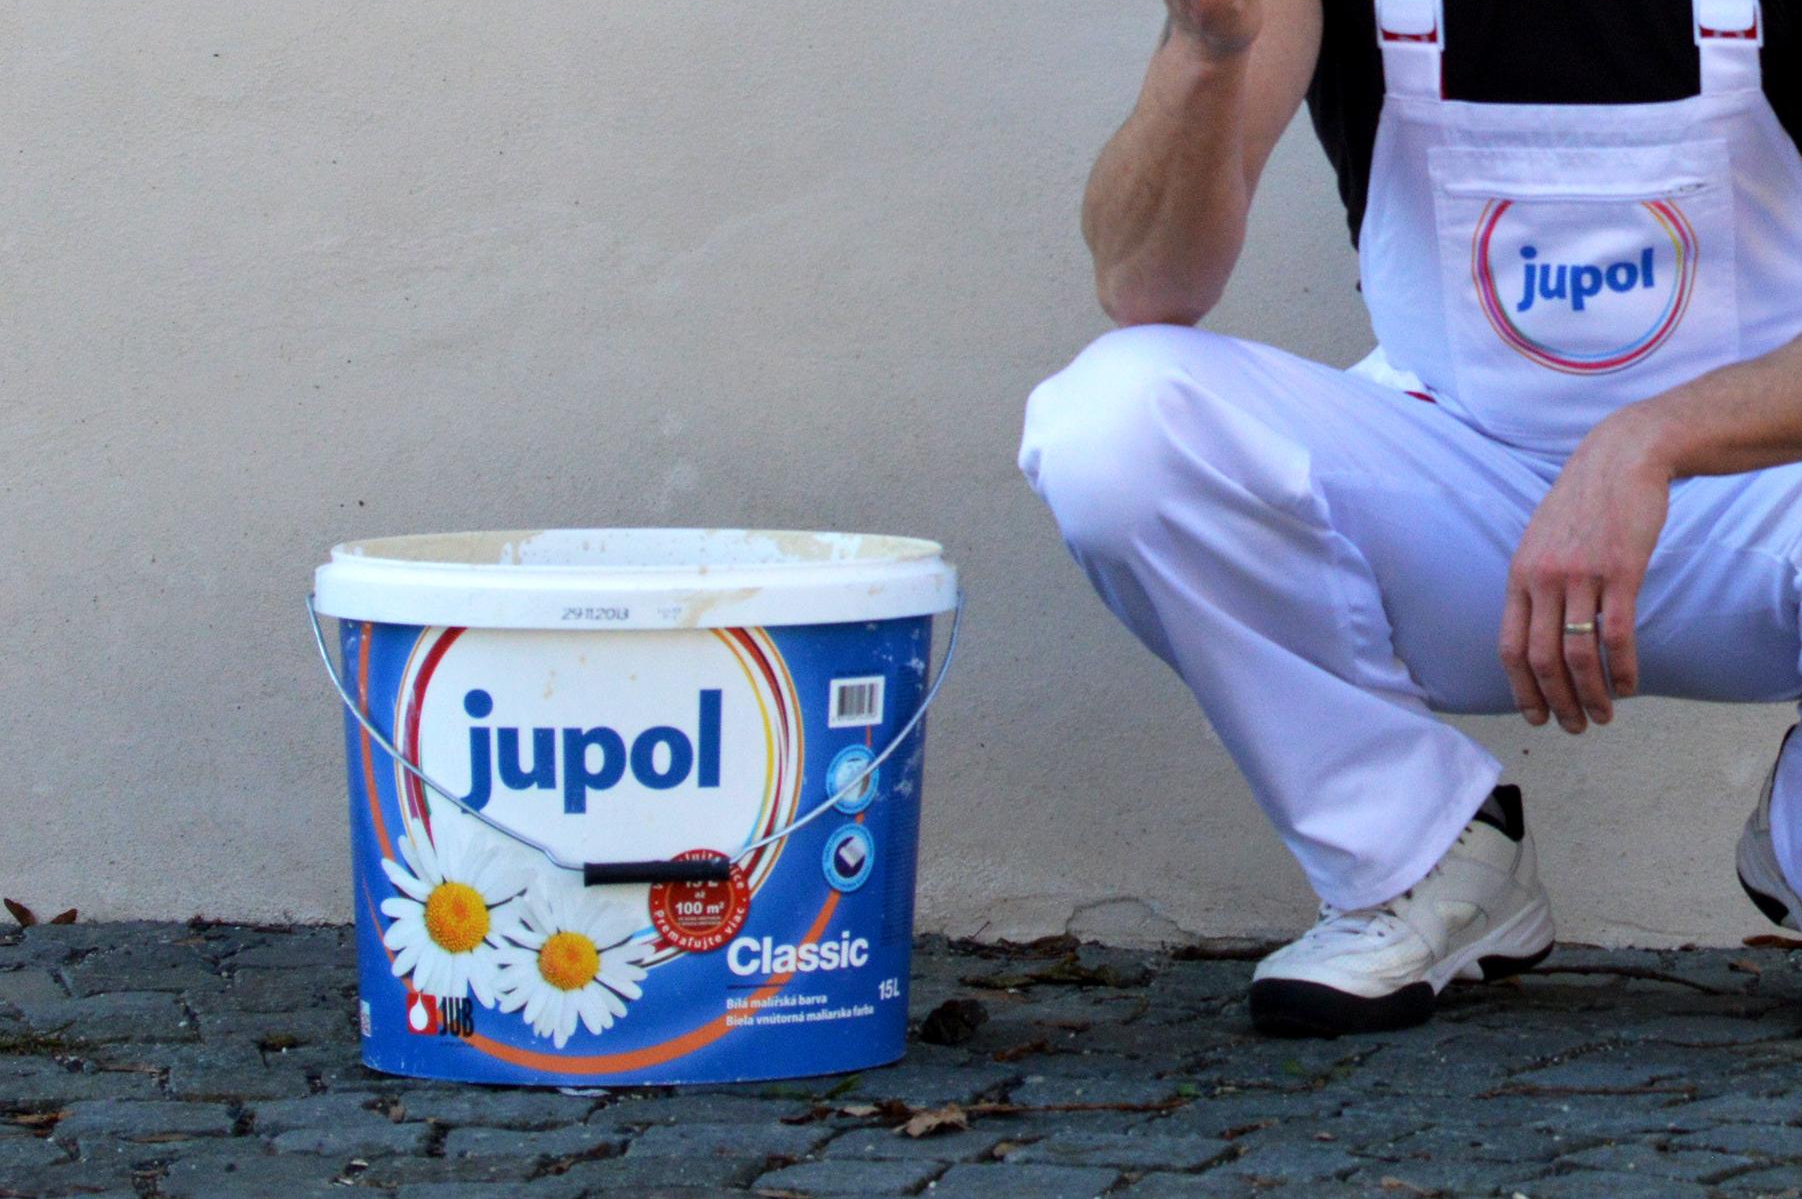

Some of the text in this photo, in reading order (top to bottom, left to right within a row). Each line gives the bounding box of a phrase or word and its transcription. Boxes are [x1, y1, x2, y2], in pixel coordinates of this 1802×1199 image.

[1517, 245, 1655, 312] jupol
[459, 688, 723, 815] jupol
[675, 901, 703, 915] 100
[726, 930, 869, 976] Classic
[439, 997, 474, 1037] JUB
